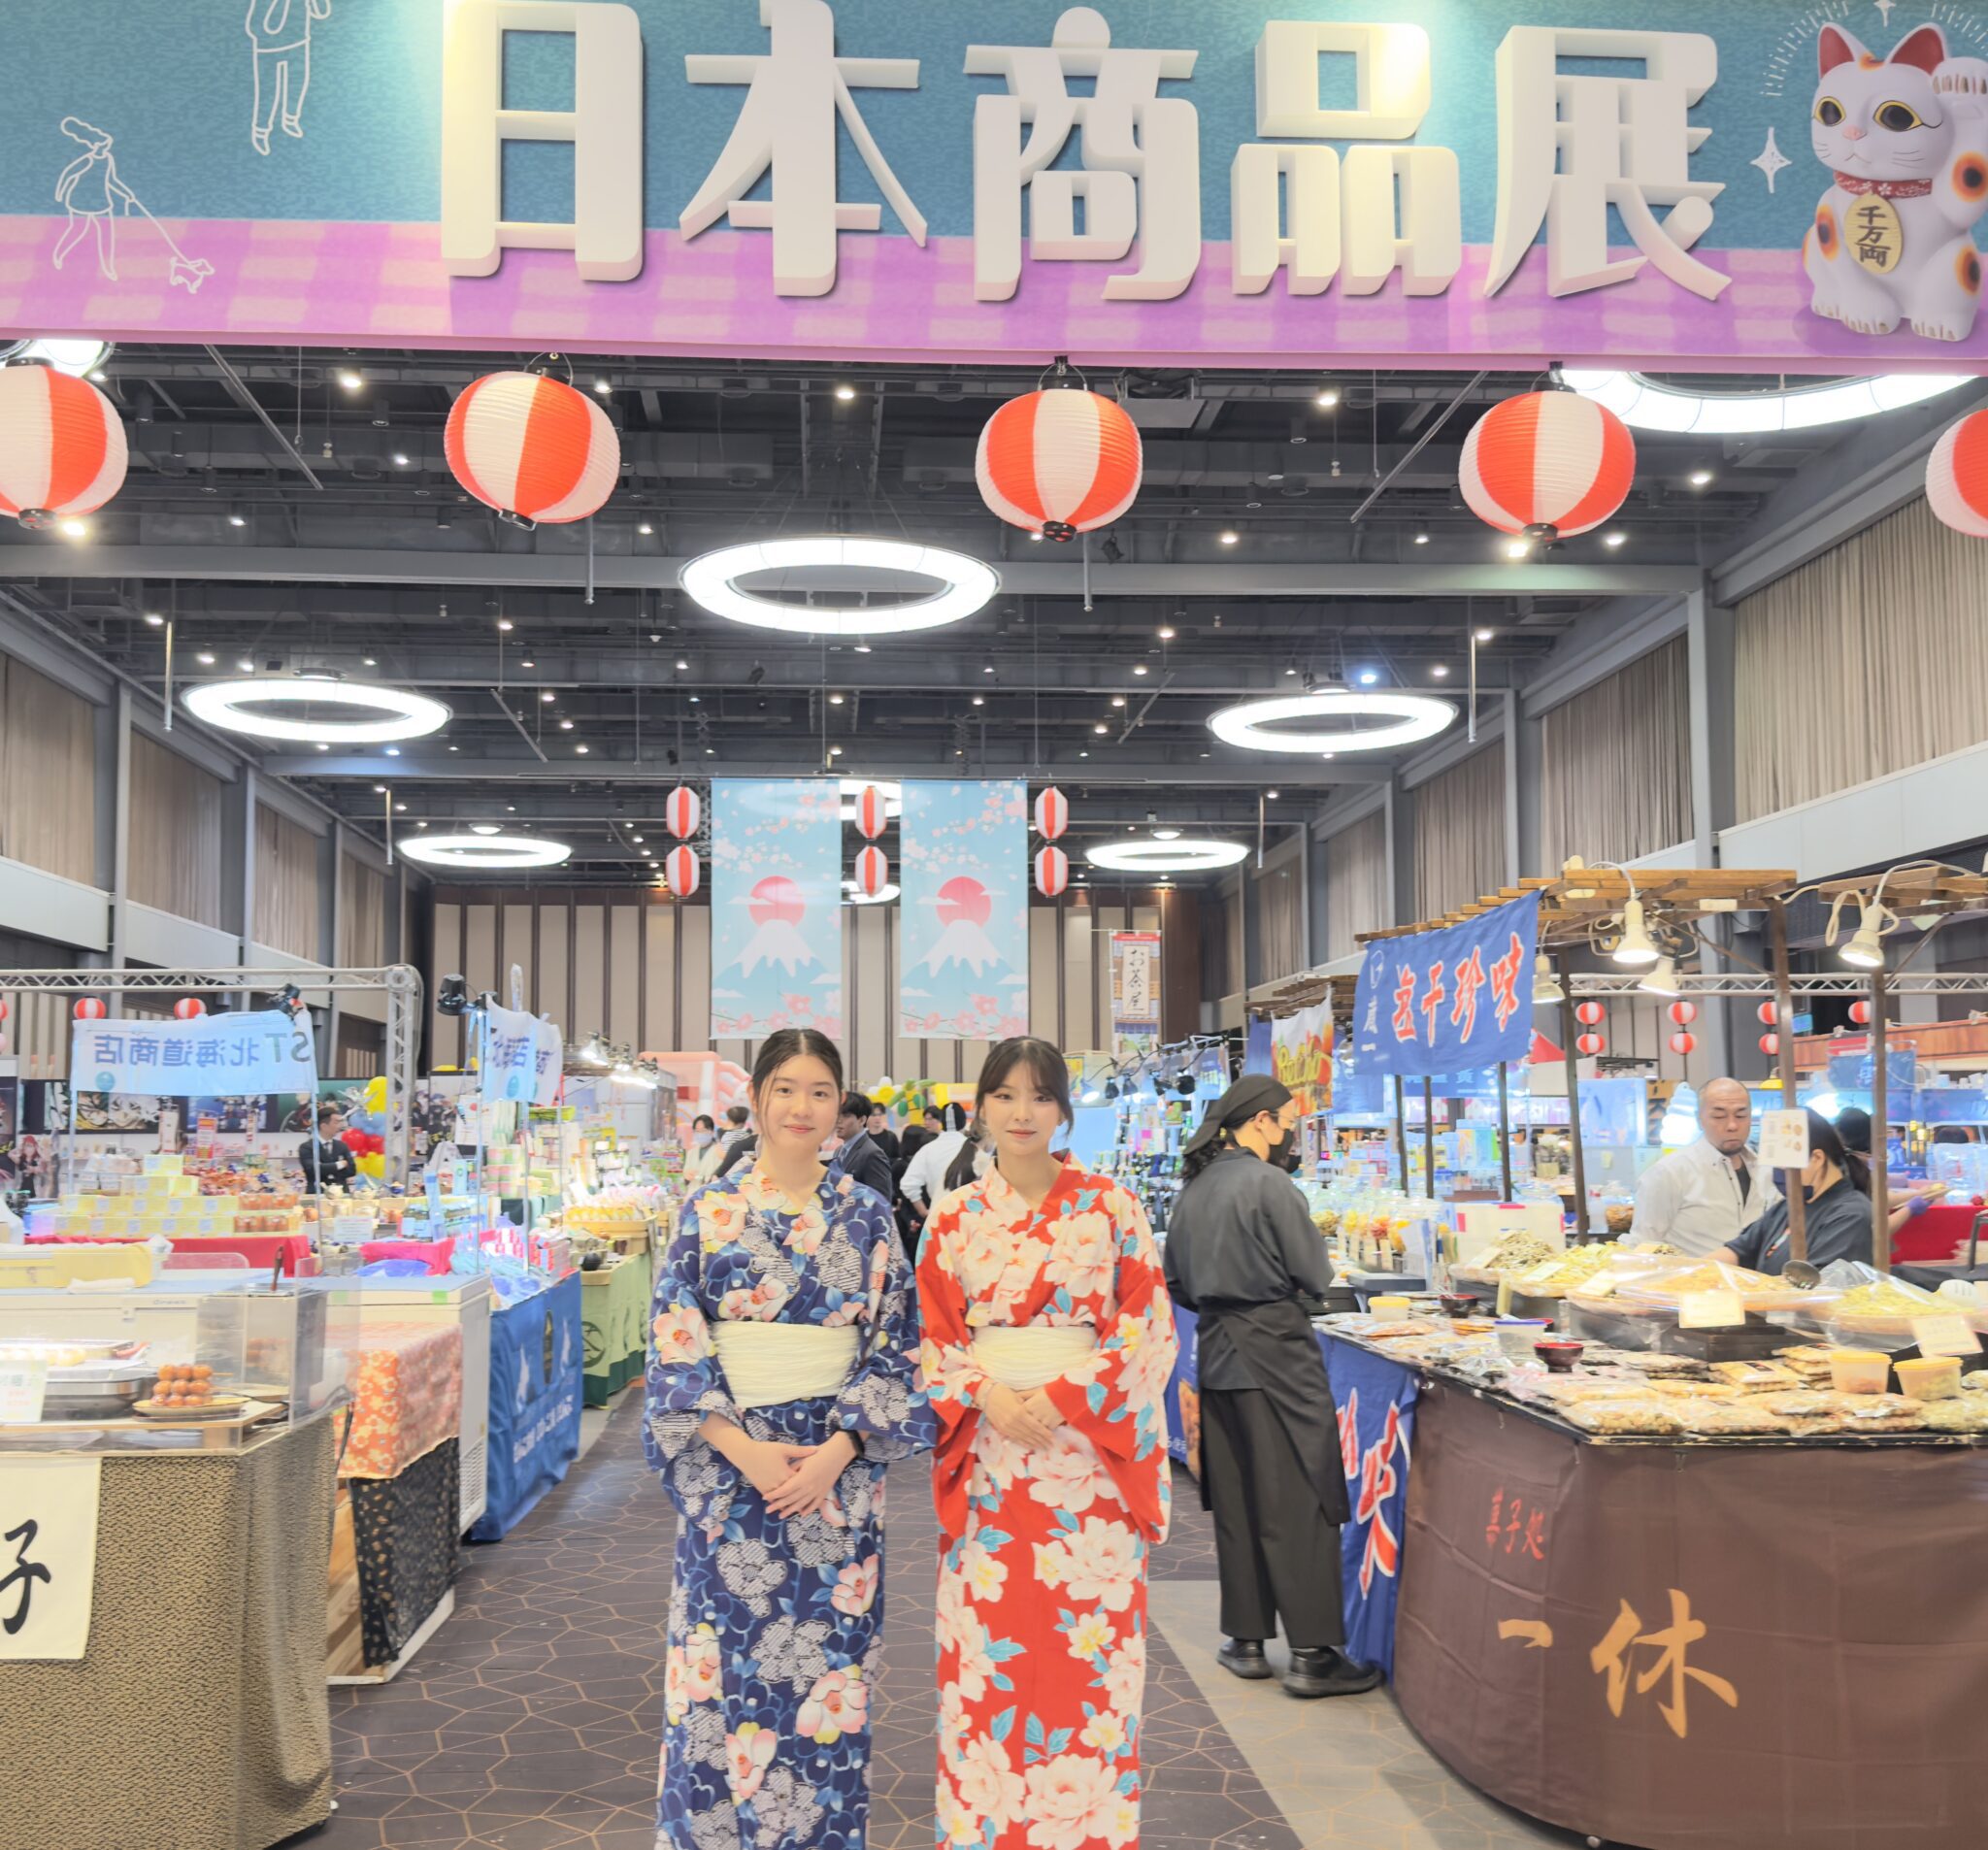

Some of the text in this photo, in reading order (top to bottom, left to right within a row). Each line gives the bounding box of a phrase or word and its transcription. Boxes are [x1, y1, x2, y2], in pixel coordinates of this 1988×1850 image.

[441, 0, 1732, 302] 日本商品展
[1854, 205, 1892, 268] 千万両
[0, 1518, 52, 1635] 子
[1496, 1587, 1740, 1740] 一休
